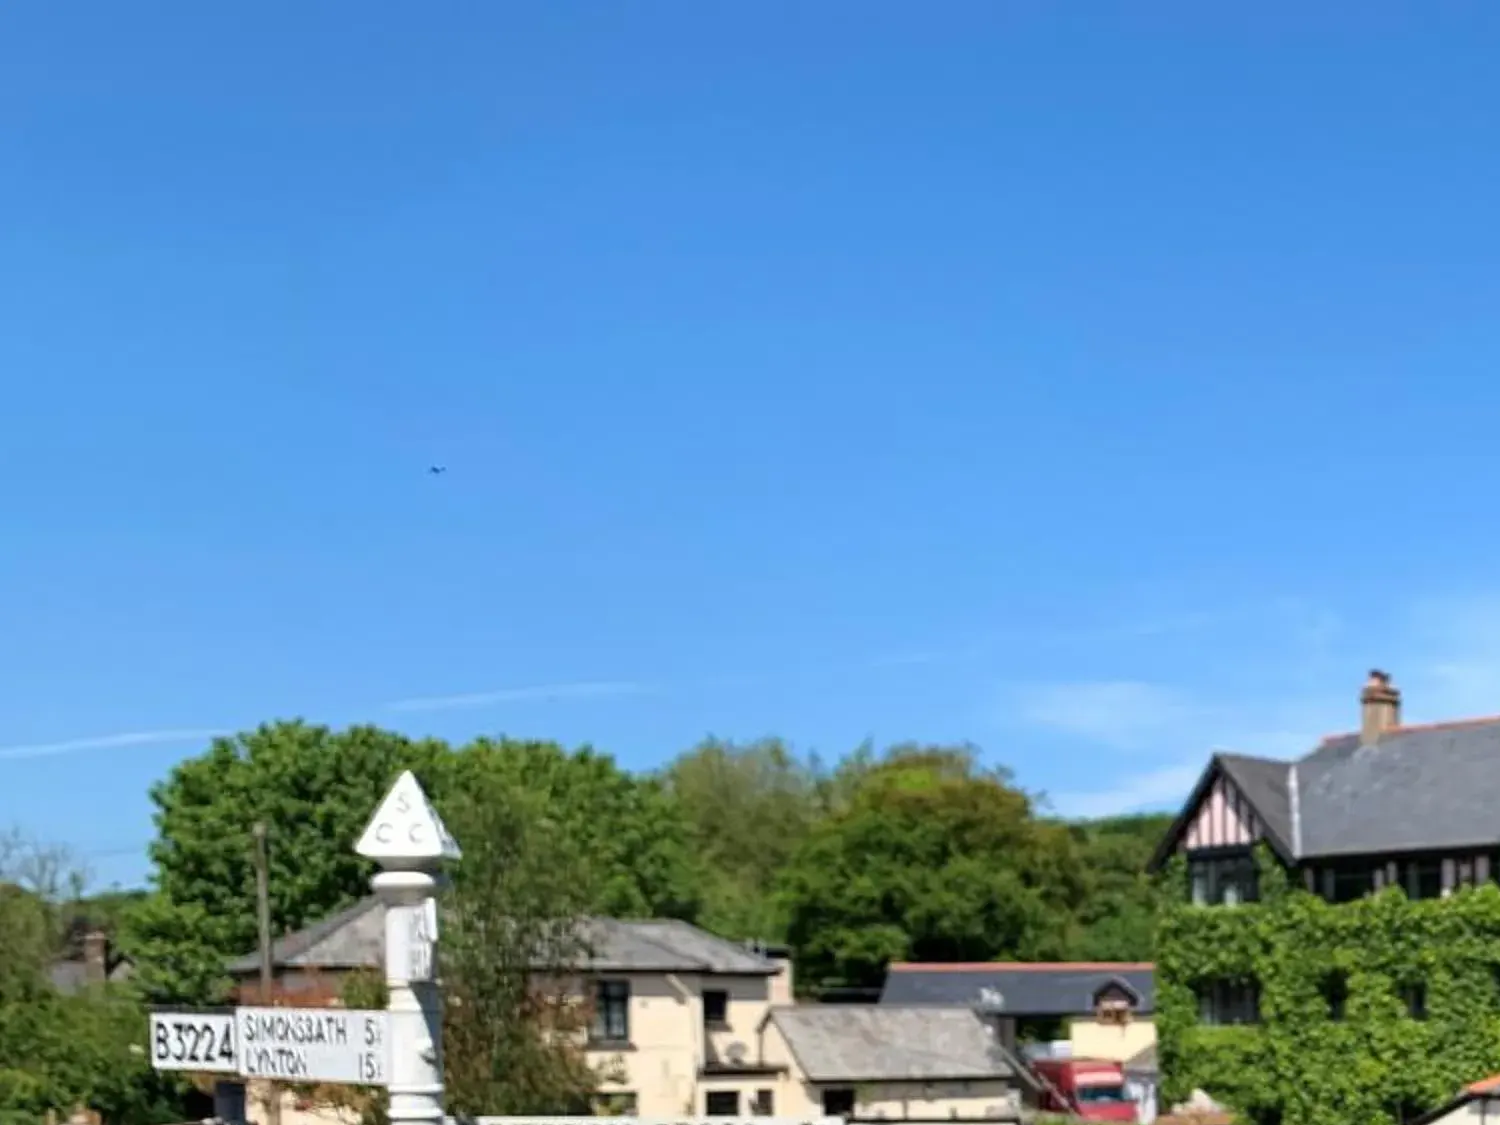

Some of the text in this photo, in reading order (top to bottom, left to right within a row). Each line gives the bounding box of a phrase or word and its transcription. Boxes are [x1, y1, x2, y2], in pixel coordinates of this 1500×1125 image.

[155, 1022, 234, 1065] B3224
[245, 1014, 348, 1045] SIMONSBATH
[246, 1047, 309, 1076] LYNTON
